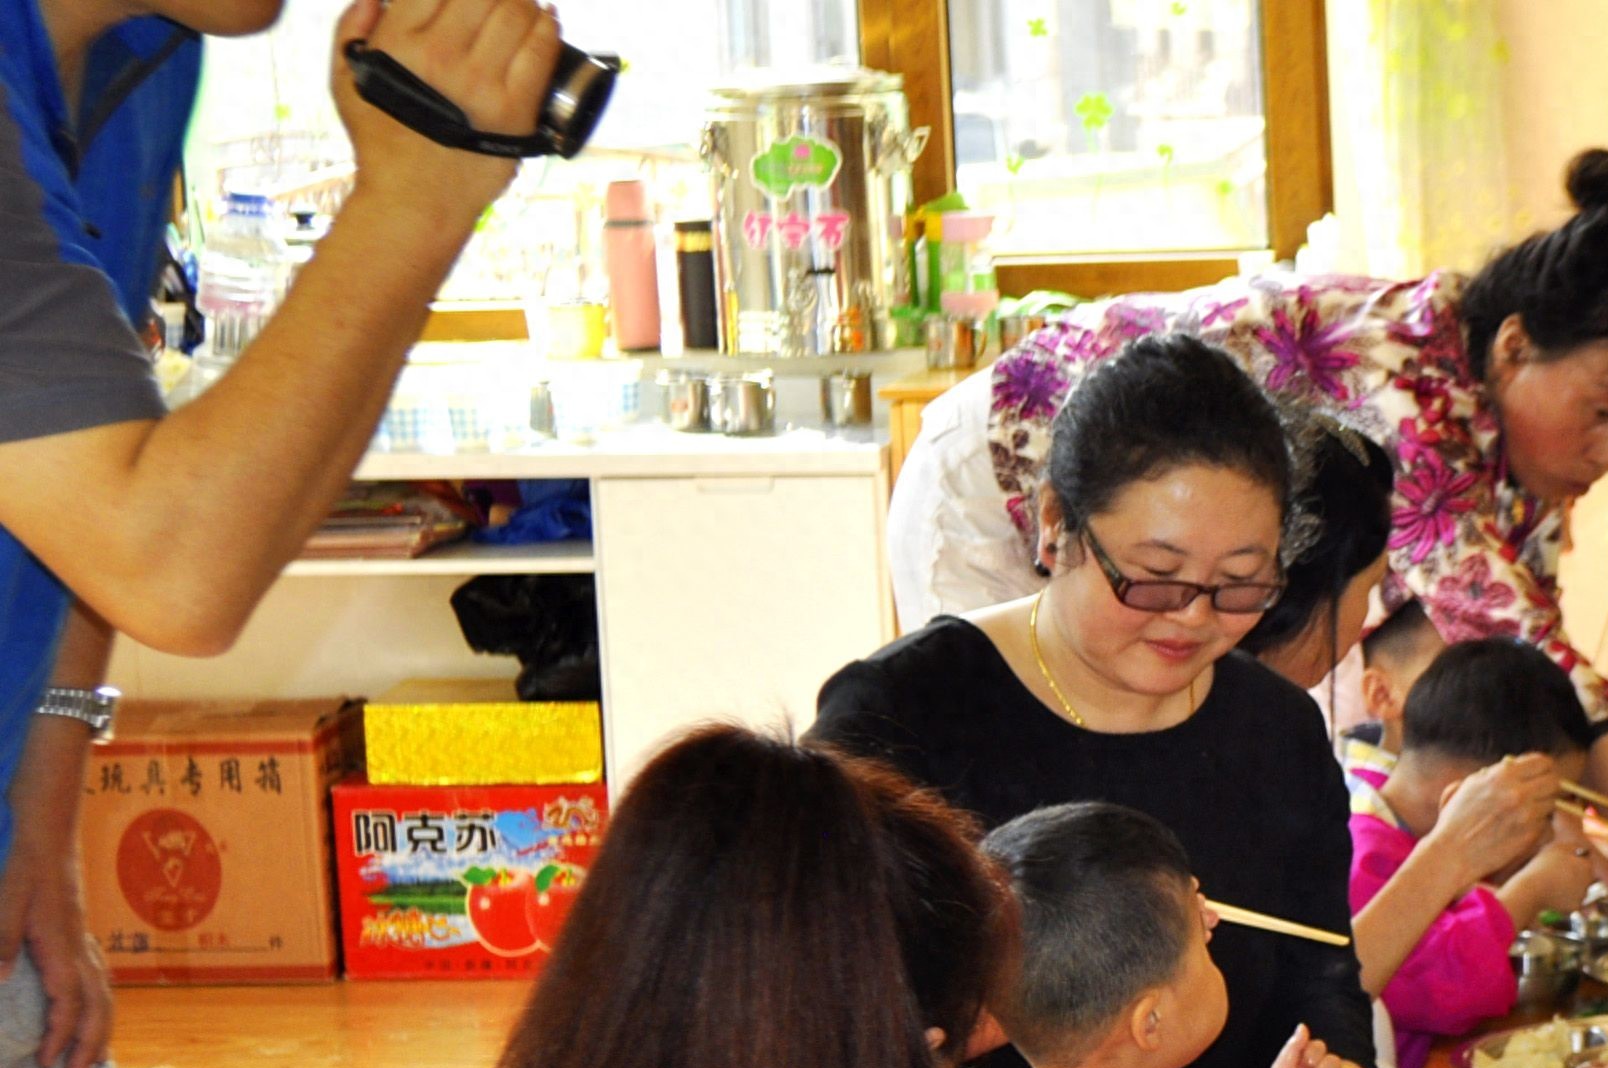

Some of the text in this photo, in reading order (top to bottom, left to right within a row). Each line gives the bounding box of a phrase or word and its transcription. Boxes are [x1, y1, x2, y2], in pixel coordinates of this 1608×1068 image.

[84, 756, 283, 796] 玩具专用箱
[353, 811, 497, 854] 阿克苏
